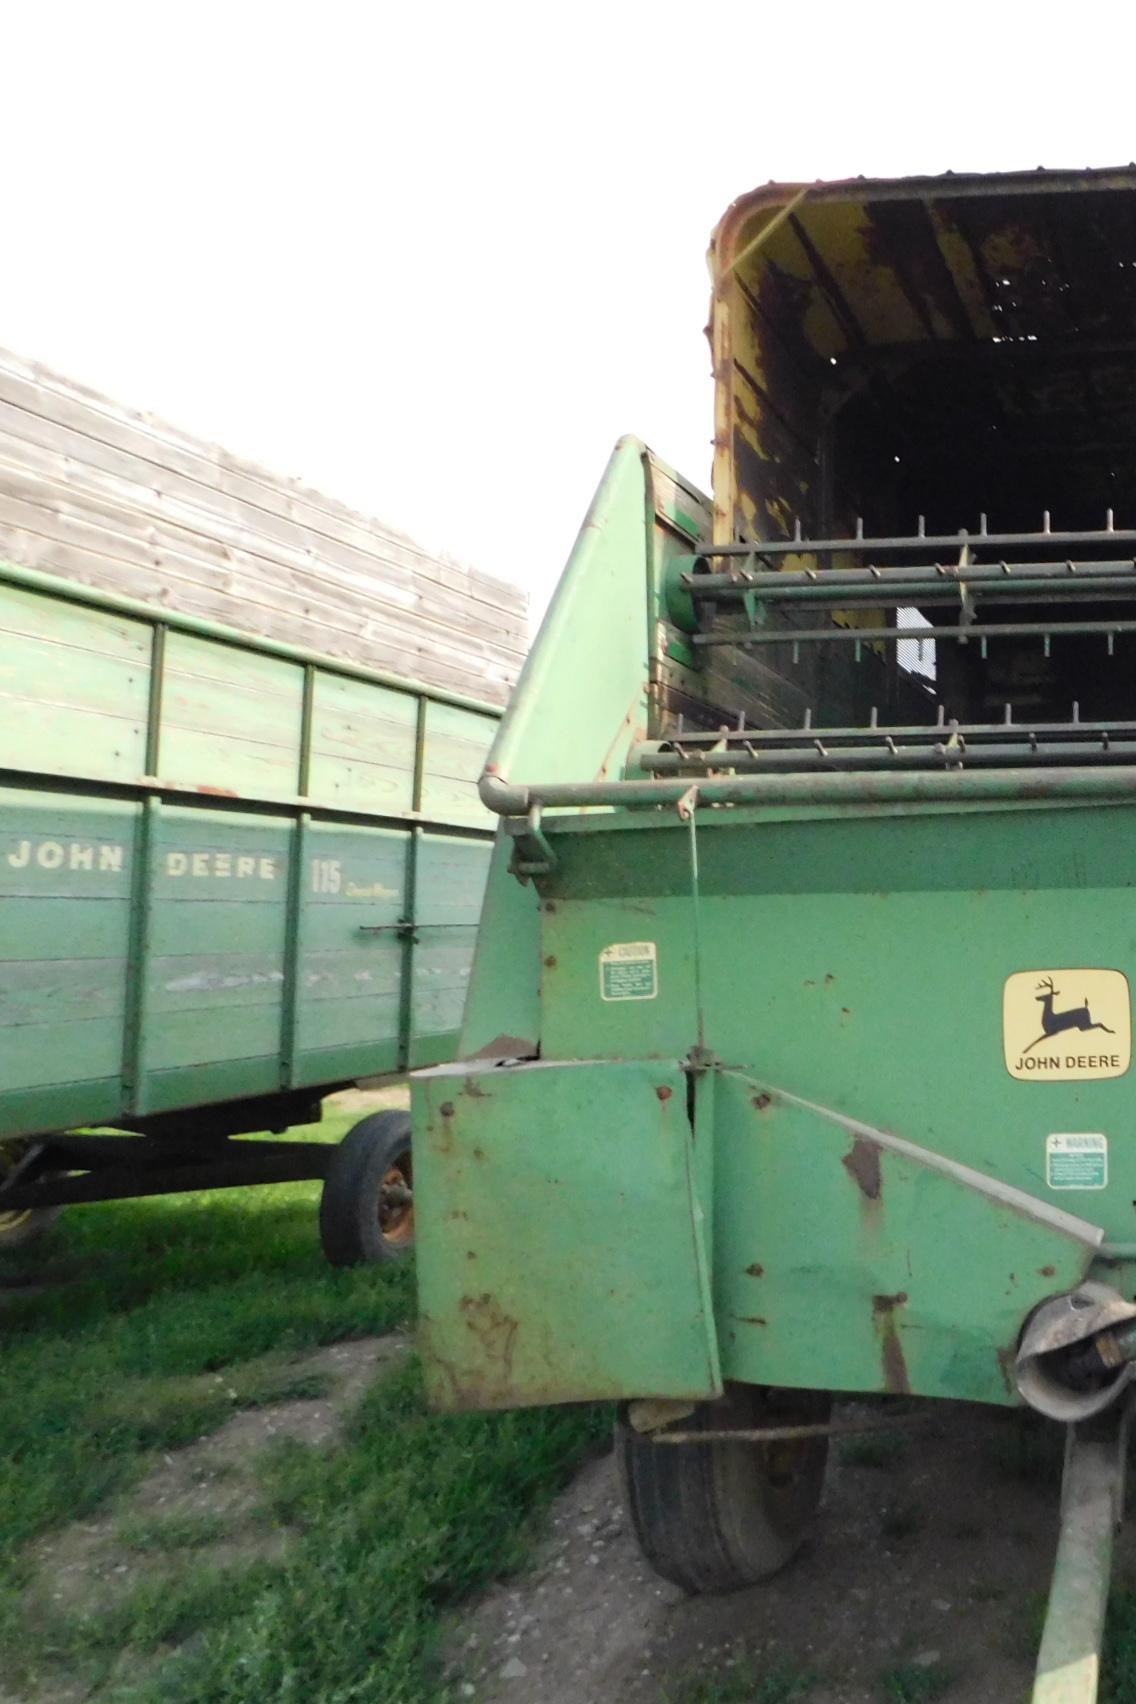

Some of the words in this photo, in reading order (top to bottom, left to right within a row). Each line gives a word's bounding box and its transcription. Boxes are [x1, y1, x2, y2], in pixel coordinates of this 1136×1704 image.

[8, 841, 122, 871] JOHN
[167, 853, 275, 879] DEERE
[312, 859, 340, 893] 115
[1015, 1057, 1060, 1070] JOHN
[1066, 1055, 1120, 1068] DEERE
